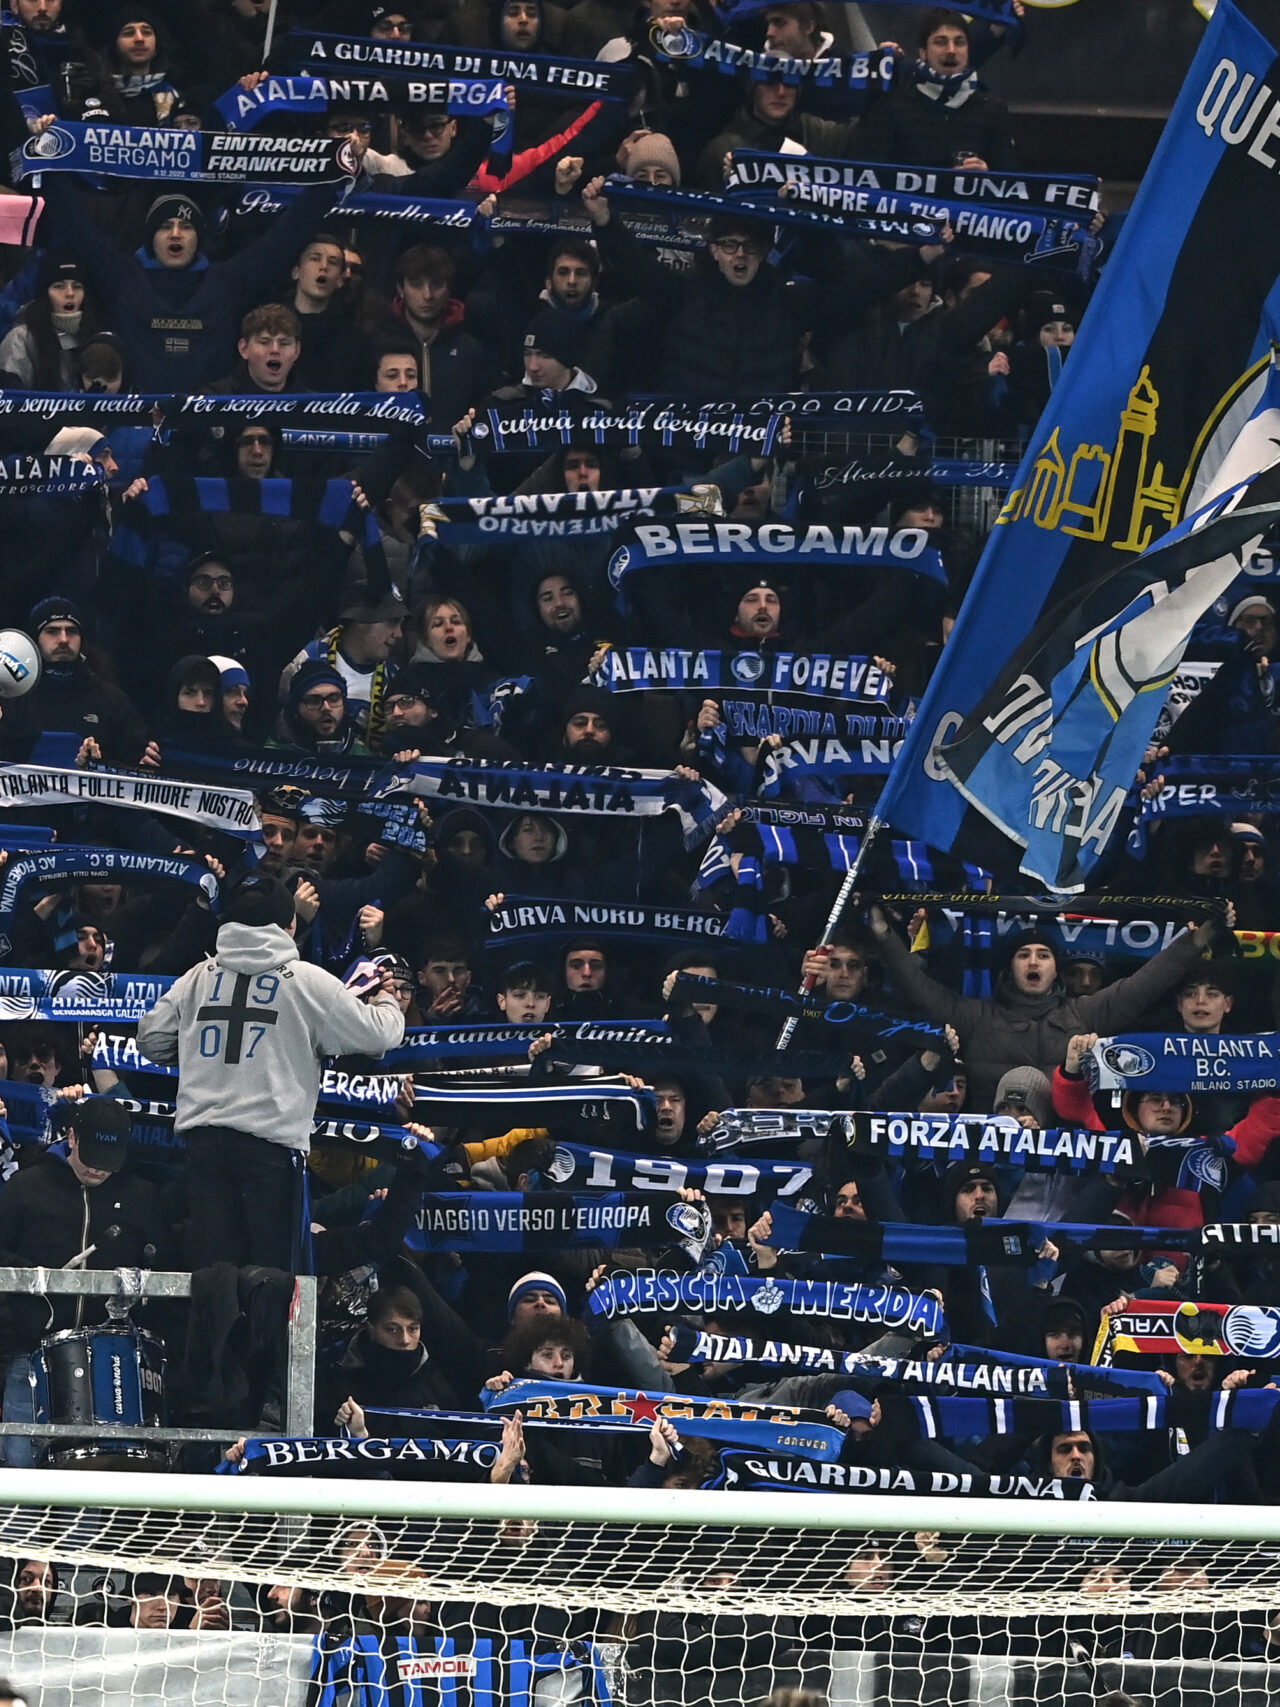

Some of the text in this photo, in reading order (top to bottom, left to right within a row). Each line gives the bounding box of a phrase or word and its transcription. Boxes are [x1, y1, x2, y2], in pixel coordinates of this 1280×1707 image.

[310, 40, 612, 91] A GUARDIA DI UNA FEDE
[704, 40, 842, 78] ATALANTA
[237, 79, 510, 118] ATALANTA BERGA
[1196, 58, 1280, 172] QUE
[83, 128, 197, 152] ATALANTA
[211, 135, 332, 154] EINTRACHT
[89, 146, 191, 168] BERGAMO
[207, 155, 332, 174] FRANKFURT
[895, 171, 937, 194] DI
[952, 176, 1030, 201] UNA
[790, 182, 869, 212] SEMPRE
[955, 211, 1033, 243] FIANCO
[19, 396, 86, 420] sempre
[219, 398, 295, 420] sempre
[303, 391, 361, 416] nella
[497, 410, 770, 443] curva nord bergamo
[36, 482, 89, 494] CUORE
[633, 523, 929, 560] BERGAMO
[78, 776, 125, 799] FOLLE
[133, 782, 192, 809] AMORE
[196, 790, 254, 826] NOSTRO
[38, 854, 57, 870] AC
[85, 852, 115, 868] B.C.
[120, 854, 190, 876] ATALANTA
[489, 904, 566, 933] CURVA
[573, 905, 646, 926] NORD
[1163, 1036, 1274, 1058] ATALANTA
[1195, 1057, 1231, 1077] B.C.
[320, 1069, 404, 1105] ERGAM
[1190, 1077, 1277, 1091] MILANO STADIO
[870, 1117, 970, 1152] FORZA
[978, 1124, 1133, 1166] ATALANTA
[585, 1151, 814, 1197] 1907
[414, 1204, 652, 1231] VIAGGIO VERSO L'EUROPA
[789, 1278, 944, 1338] MERDA
[690, 1330, 1049, 1395] ATALANTA ATALANTA
[140, 1367, 163, 1396] 1907
[261, 1437, 502, 1469] BERGAMO
[743, 1457, 1066, 1500] GUARDIA DI UNA
[398, 1660, 470, 1677] TAMOIL
